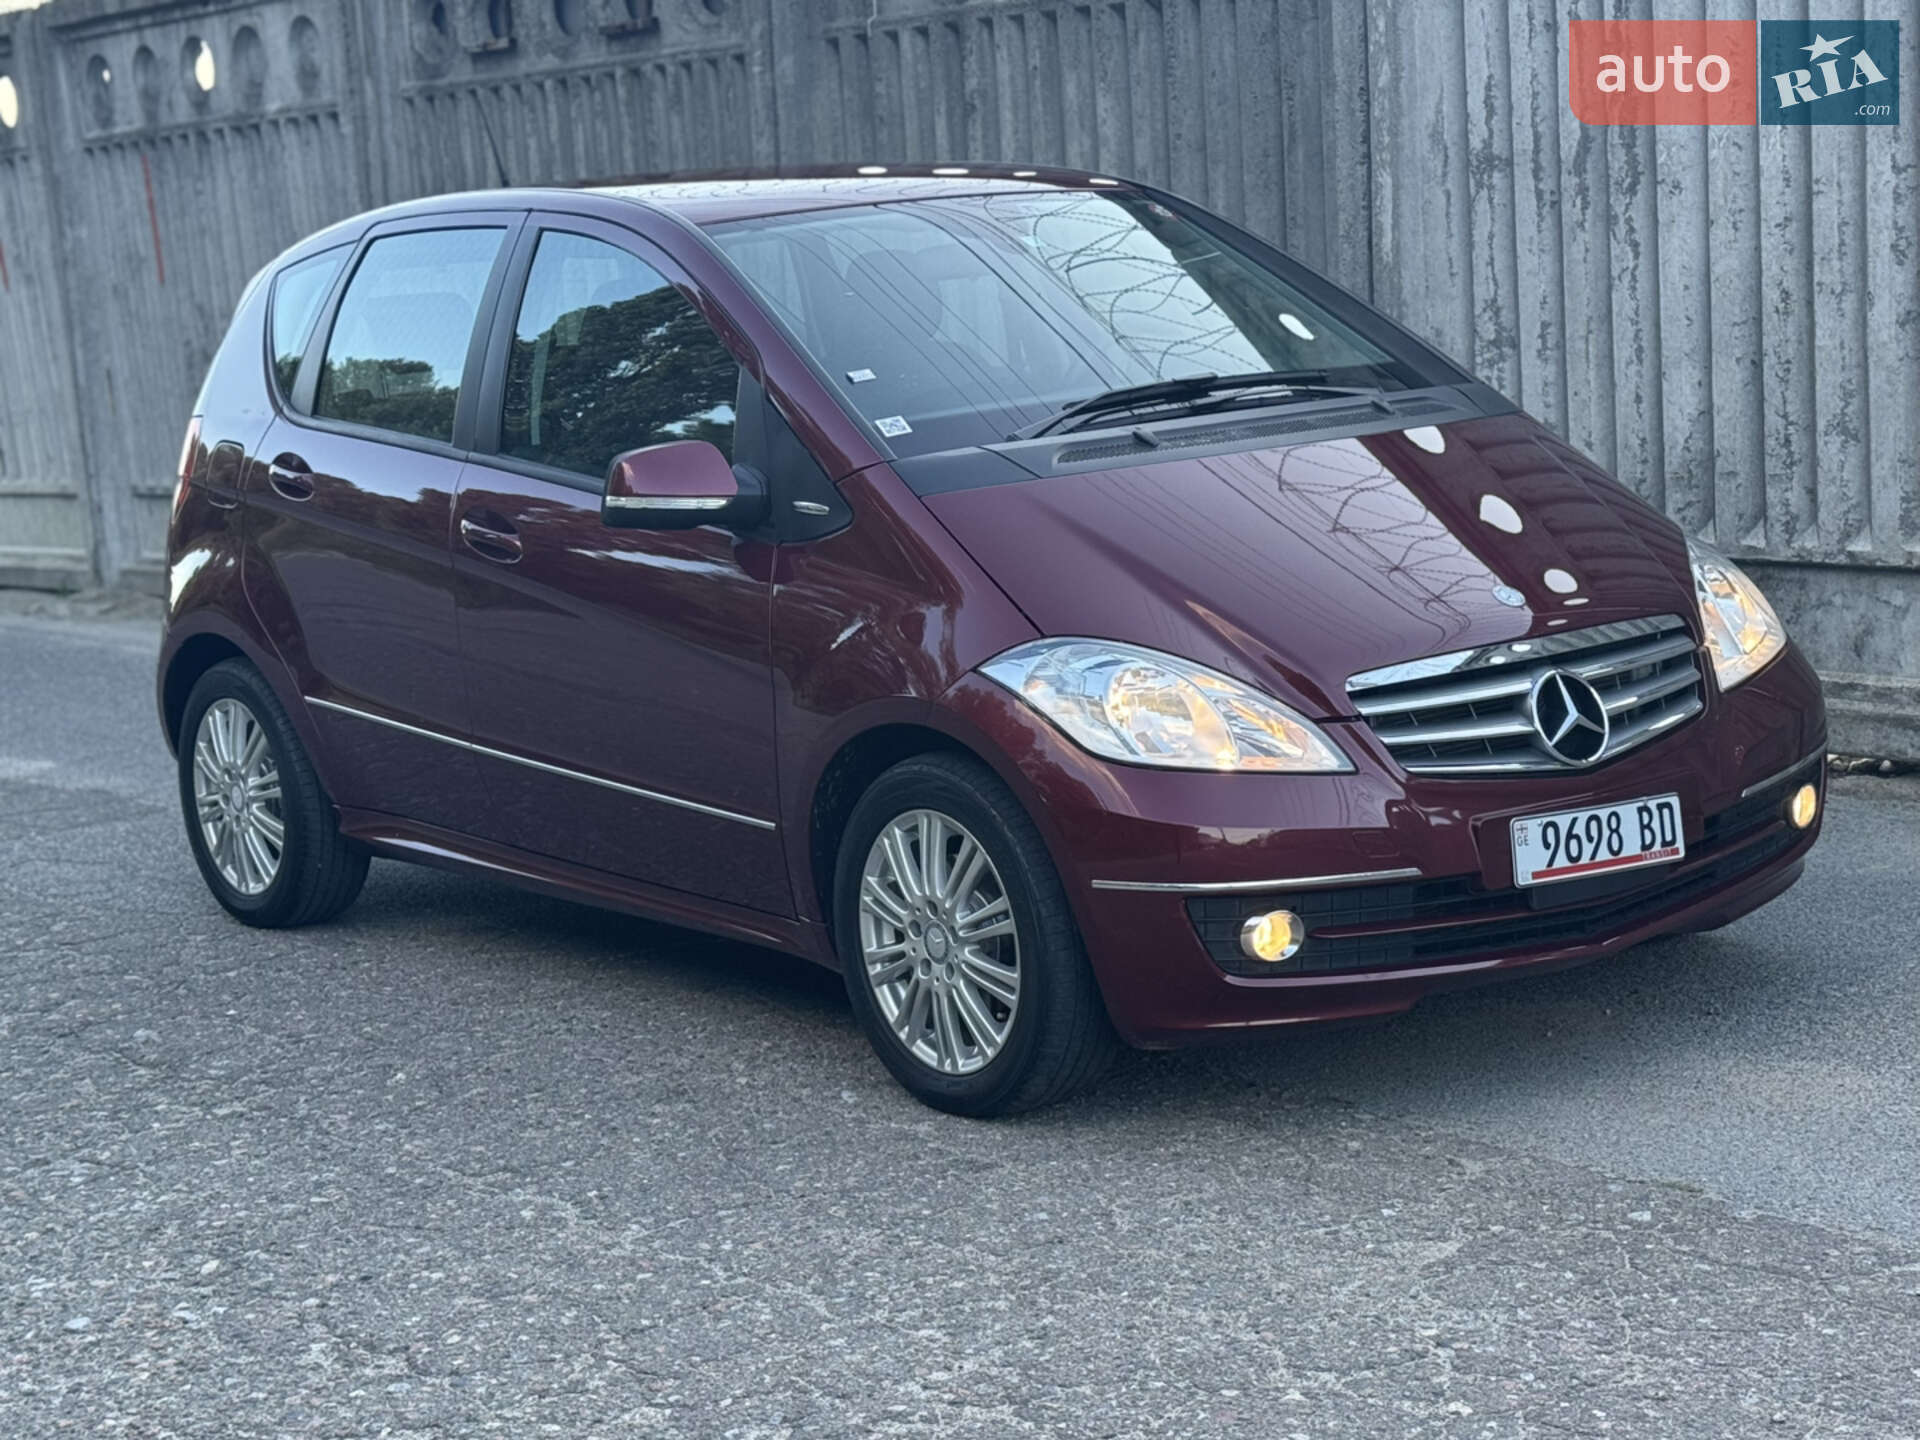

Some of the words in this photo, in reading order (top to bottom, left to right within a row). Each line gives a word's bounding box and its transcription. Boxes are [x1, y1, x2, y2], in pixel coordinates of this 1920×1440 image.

[1516, 834, 1529, 847] GE
[1541, 811, 1624, 868] 9698
[1637, 801, 1677, 851] BD
